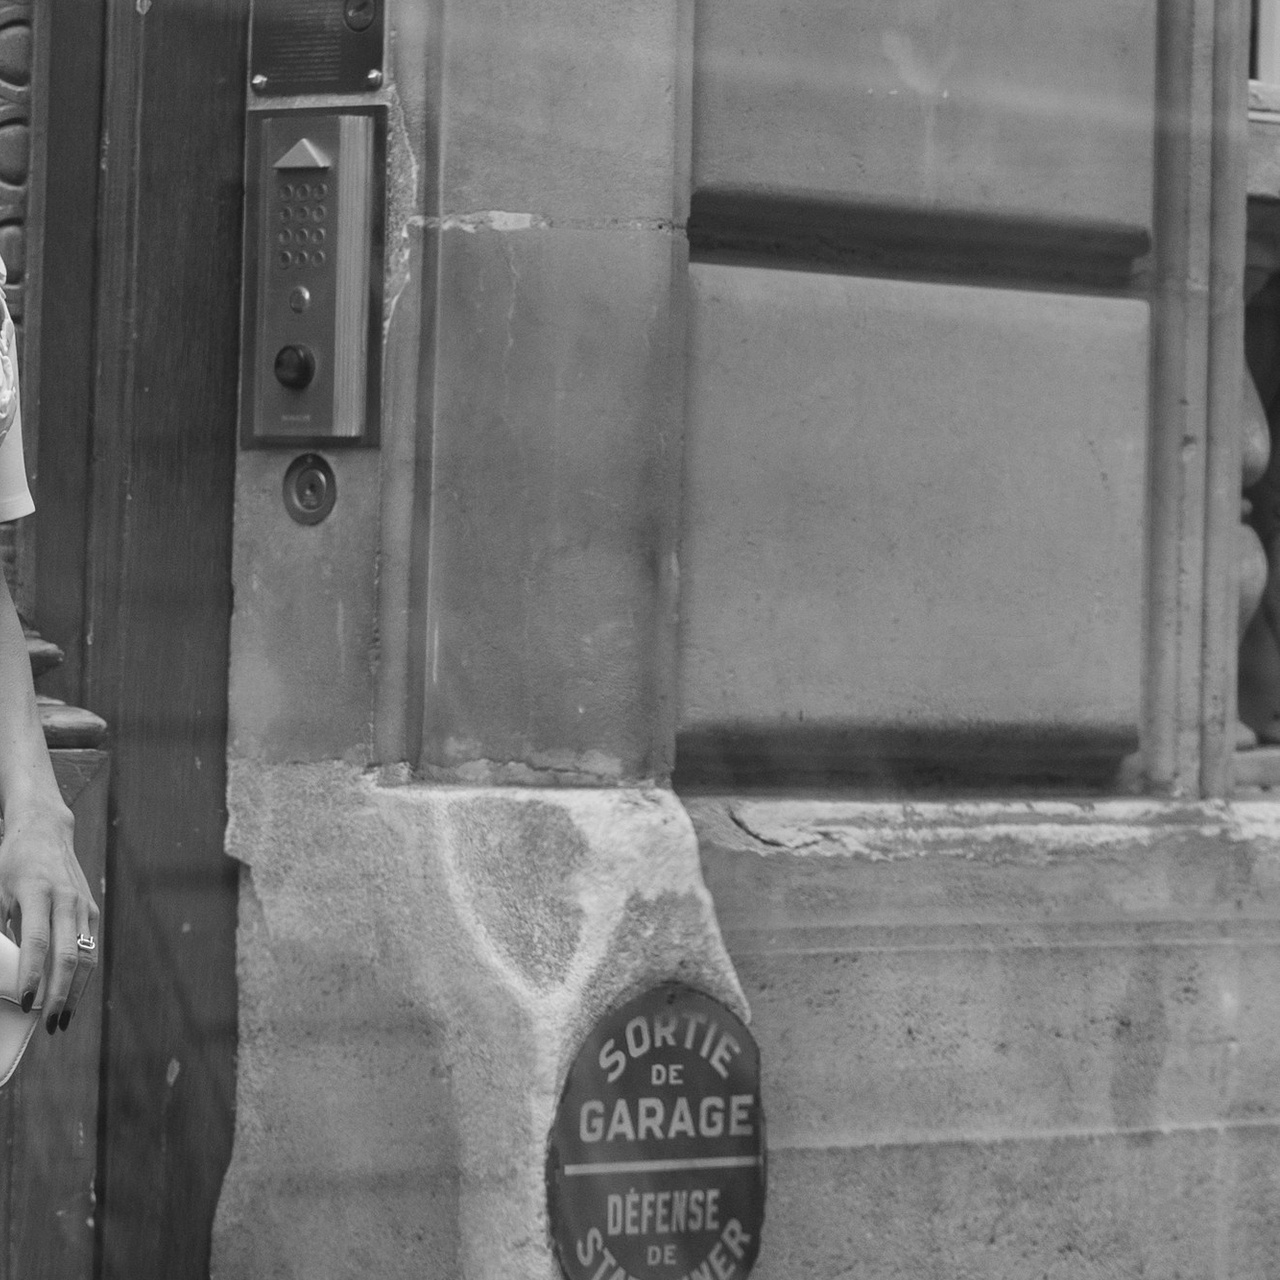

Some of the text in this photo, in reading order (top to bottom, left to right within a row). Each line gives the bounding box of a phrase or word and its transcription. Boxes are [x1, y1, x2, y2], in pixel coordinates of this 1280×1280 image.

[598, 1014, 741, 1083] SORTIE
[651, 1064, 684, 1085] DE
[579, 1094, 754, 1142] GARAGE
[647, 1245, 676, 1265] DE
